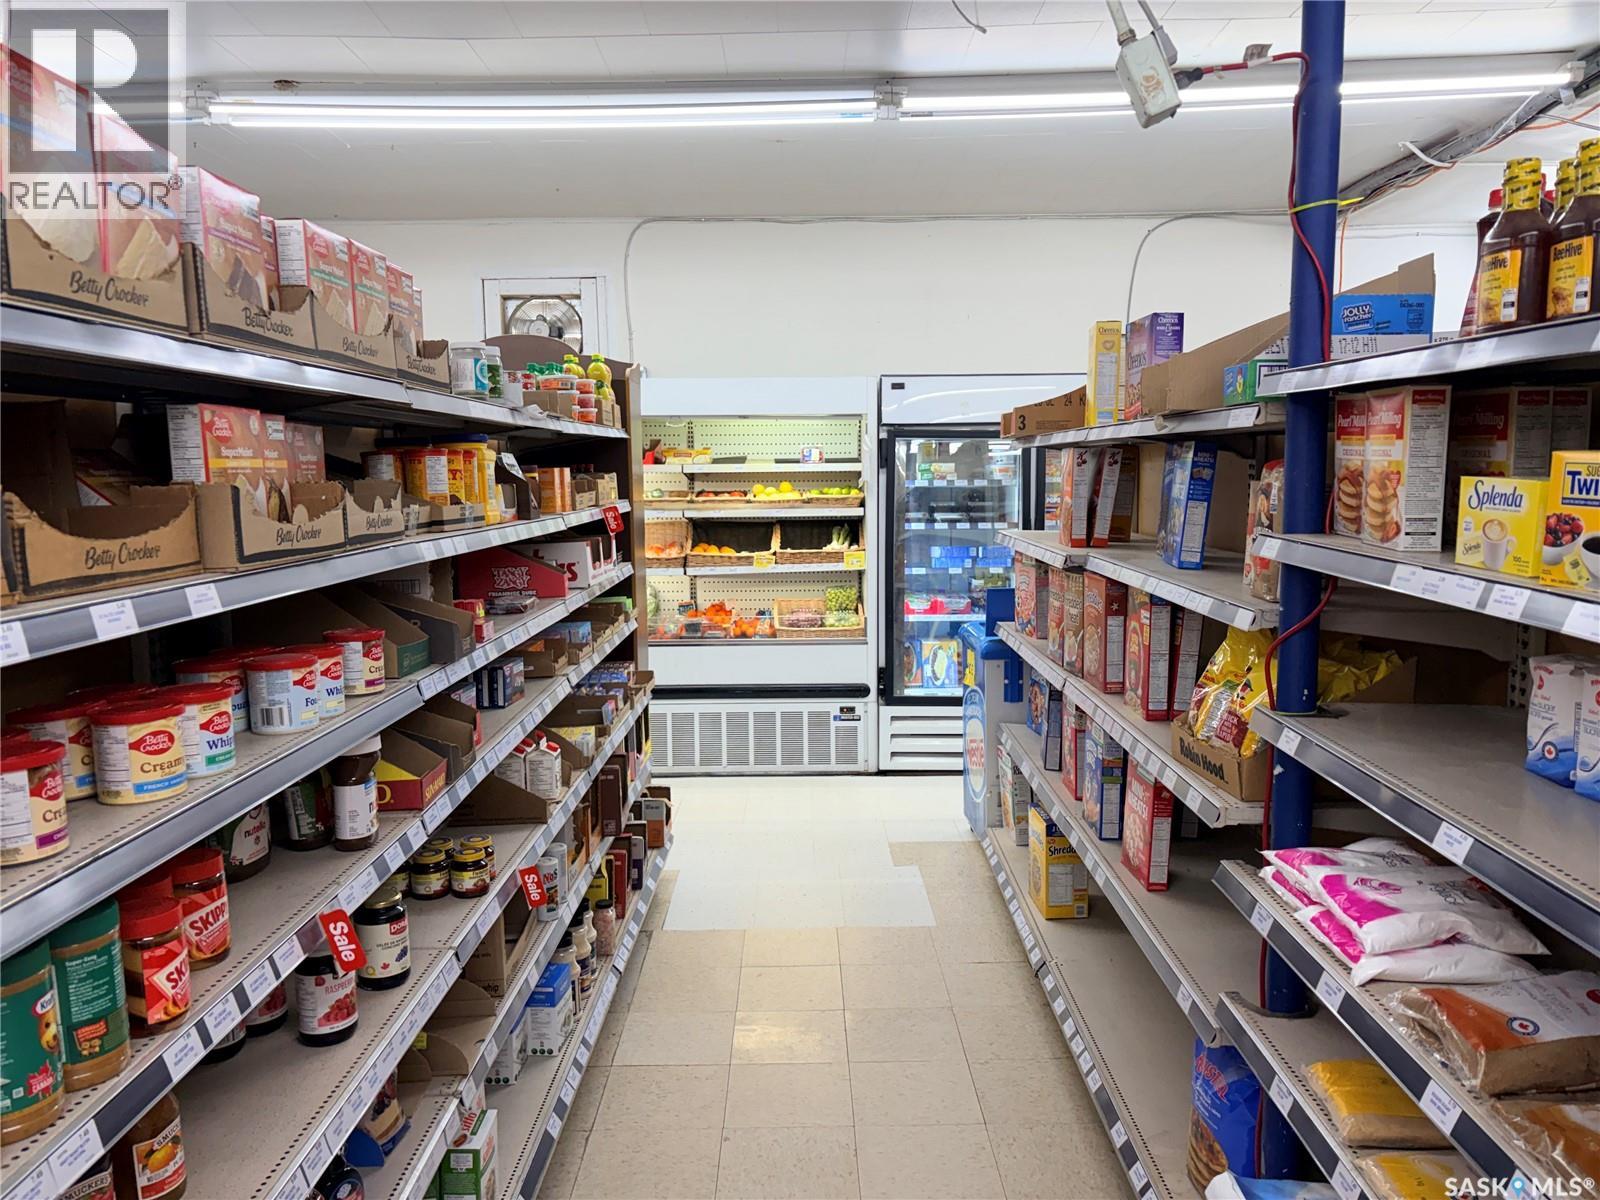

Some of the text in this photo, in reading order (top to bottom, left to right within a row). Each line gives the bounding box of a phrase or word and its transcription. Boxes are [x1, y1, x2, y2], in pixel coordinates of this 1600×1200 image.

[69, 271, 149, 308] Betty Crocker
[242, 307, 294, 338] Betty Crocker
[1342, 304, 1371, 318] JOLLY
[341, 336, 378, 358] Betty Crocker
[407, 354, 437, 376] Betty Crocker
[1018, 414, 1027, 431] 3
[1468, 480, 1524, 511] Splenda
[366, 512, 394, 532] Betty Crocker
[604, 510, 619, 530] Sale
[276, 524, 322, 548] Betty Crocker
[85, 540, 162, 571] Betty Crocker
[139, 741, 173, 754] Crocker
[143, 732, 170, 748] Betty
[1179, 737, 1224, 782] Robin Hood
[524, 873, 541, 902] Sale
[328, 920, 357, 963] Sale
